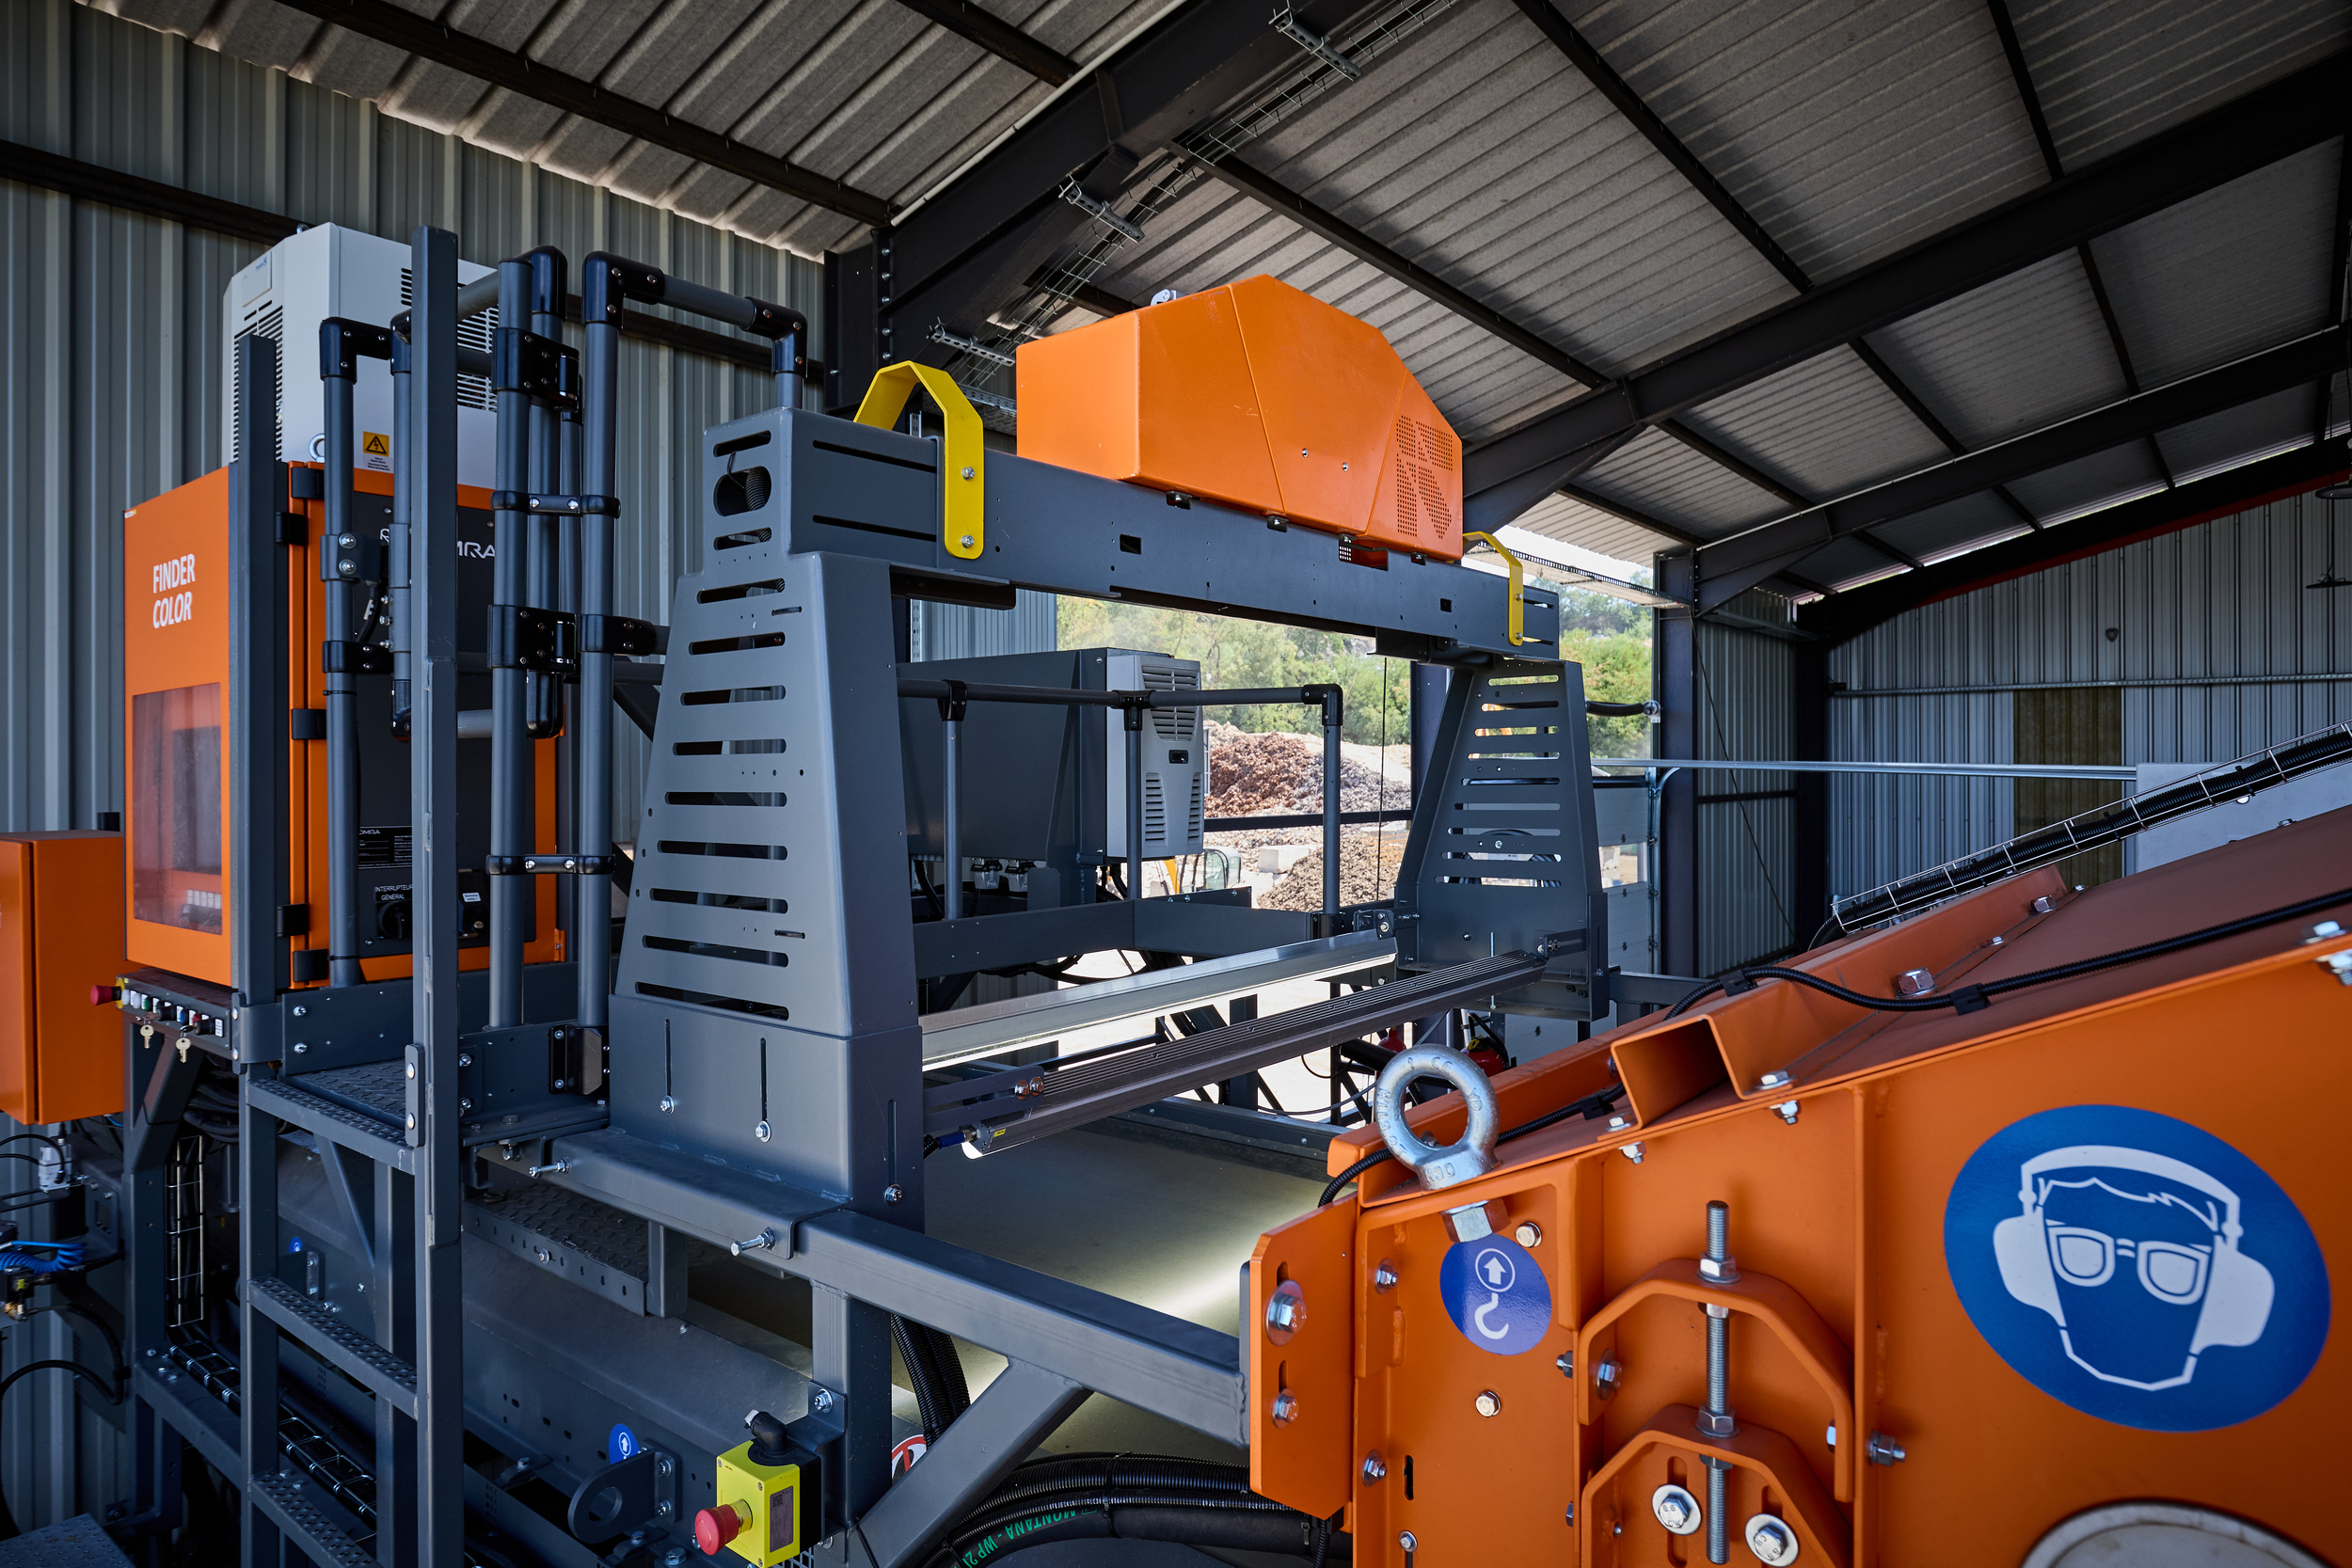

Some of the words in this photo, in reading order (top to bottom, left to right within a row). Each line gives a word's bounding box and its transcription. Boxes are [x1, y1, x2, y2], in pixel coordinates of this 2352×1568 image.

[153, 553, 196, 594] FINDER
[152, 591, 192, 629] COLOR
[977, 1535, 998, 1560] WP
